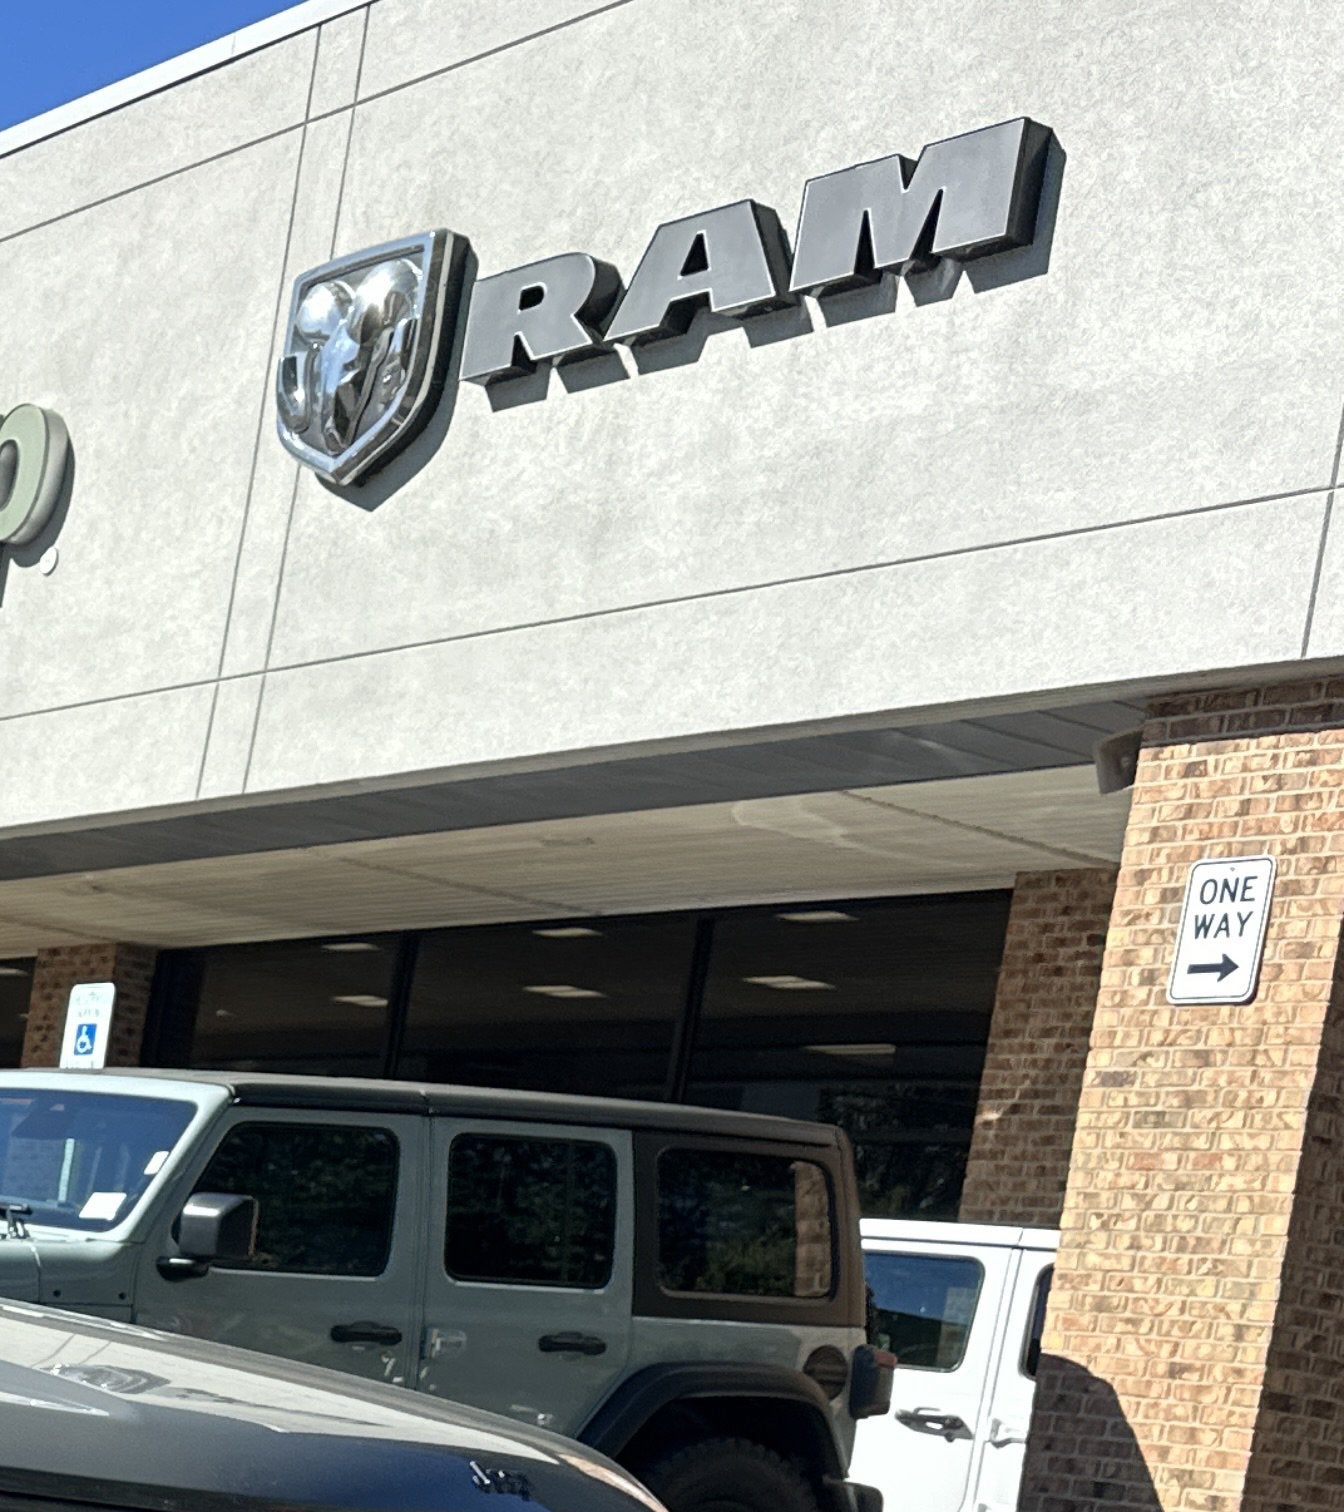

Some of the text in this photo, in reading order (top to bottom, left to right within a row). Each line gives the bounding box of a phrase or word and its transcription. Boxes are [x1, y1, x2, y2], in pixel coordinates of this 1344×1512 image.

[459, 117, 1042, 383] RAM
[1199, 876, 1258, 904] ONE
[1194, 911, 1253, 939] WAY
